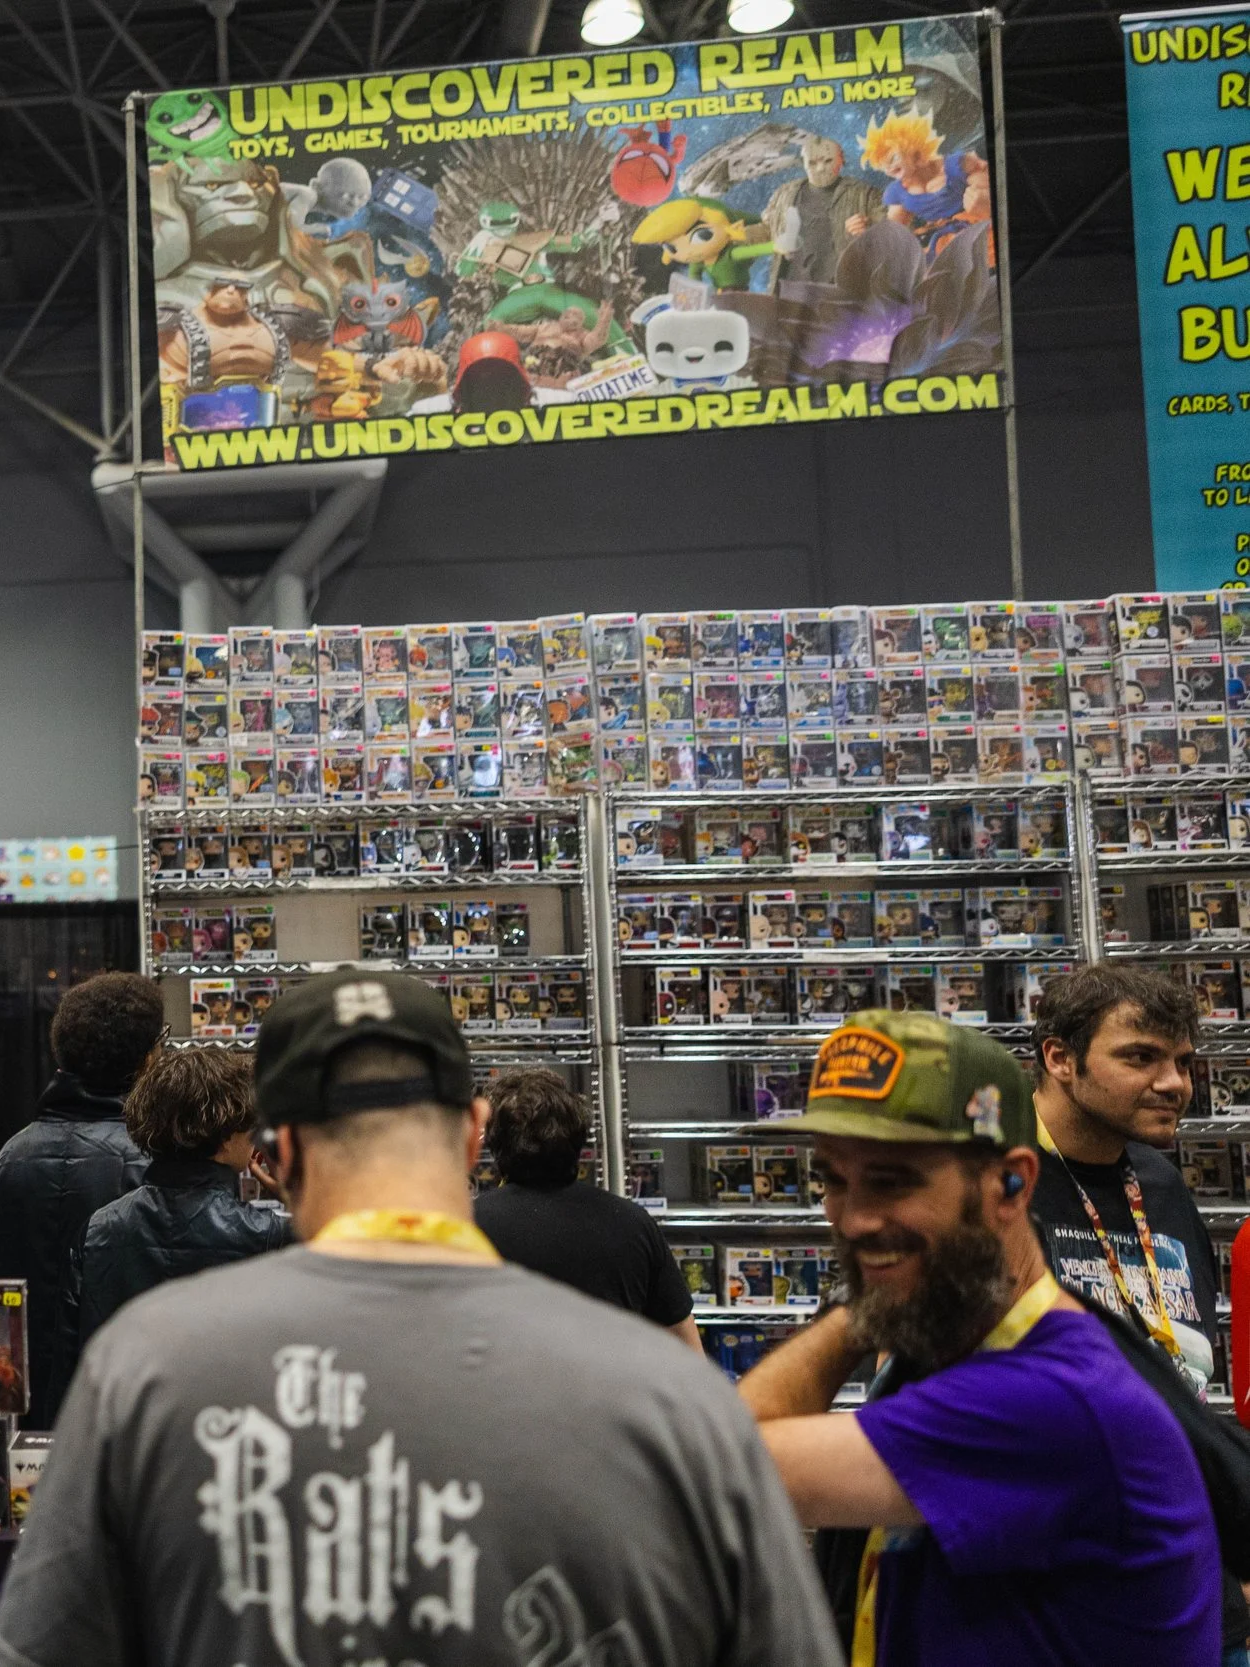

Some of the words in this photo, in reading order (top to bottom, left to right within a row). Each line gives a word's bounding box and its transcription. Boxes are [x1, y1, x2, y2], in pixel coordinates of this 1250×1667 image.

[1132, 24, 1250, 63] UNDIS
[229, 49, 676, 136] UNDISCOVERED
[700, 25, 904, 91] REALM
[1220, 73, 1250, 107] R
[229, 134, 295, 162] TOYS,
[303, 126, 391, 154] GAMES,
[395, 111, 576, 147] TOURNAMENTS,
[587, 92, 773, 128] COLLECTIBLES,
[781, 85, 834, 107] AND
[843, 75, 915, 102] MORE
[1166, 226, 1250, 283] AL
[174, 373, 999, 470] WWW.UNDISCOVEREDREALM.COM
[1168, 395, 1232, 416] CARDS,
[1204, 489, 1229, 506] TO
[1054, 1228, 1098, 1242] SHAQUILL
[1108, 1234, 1134, 1245] 'NEAL
[272, 1344, 367, 1450] The
